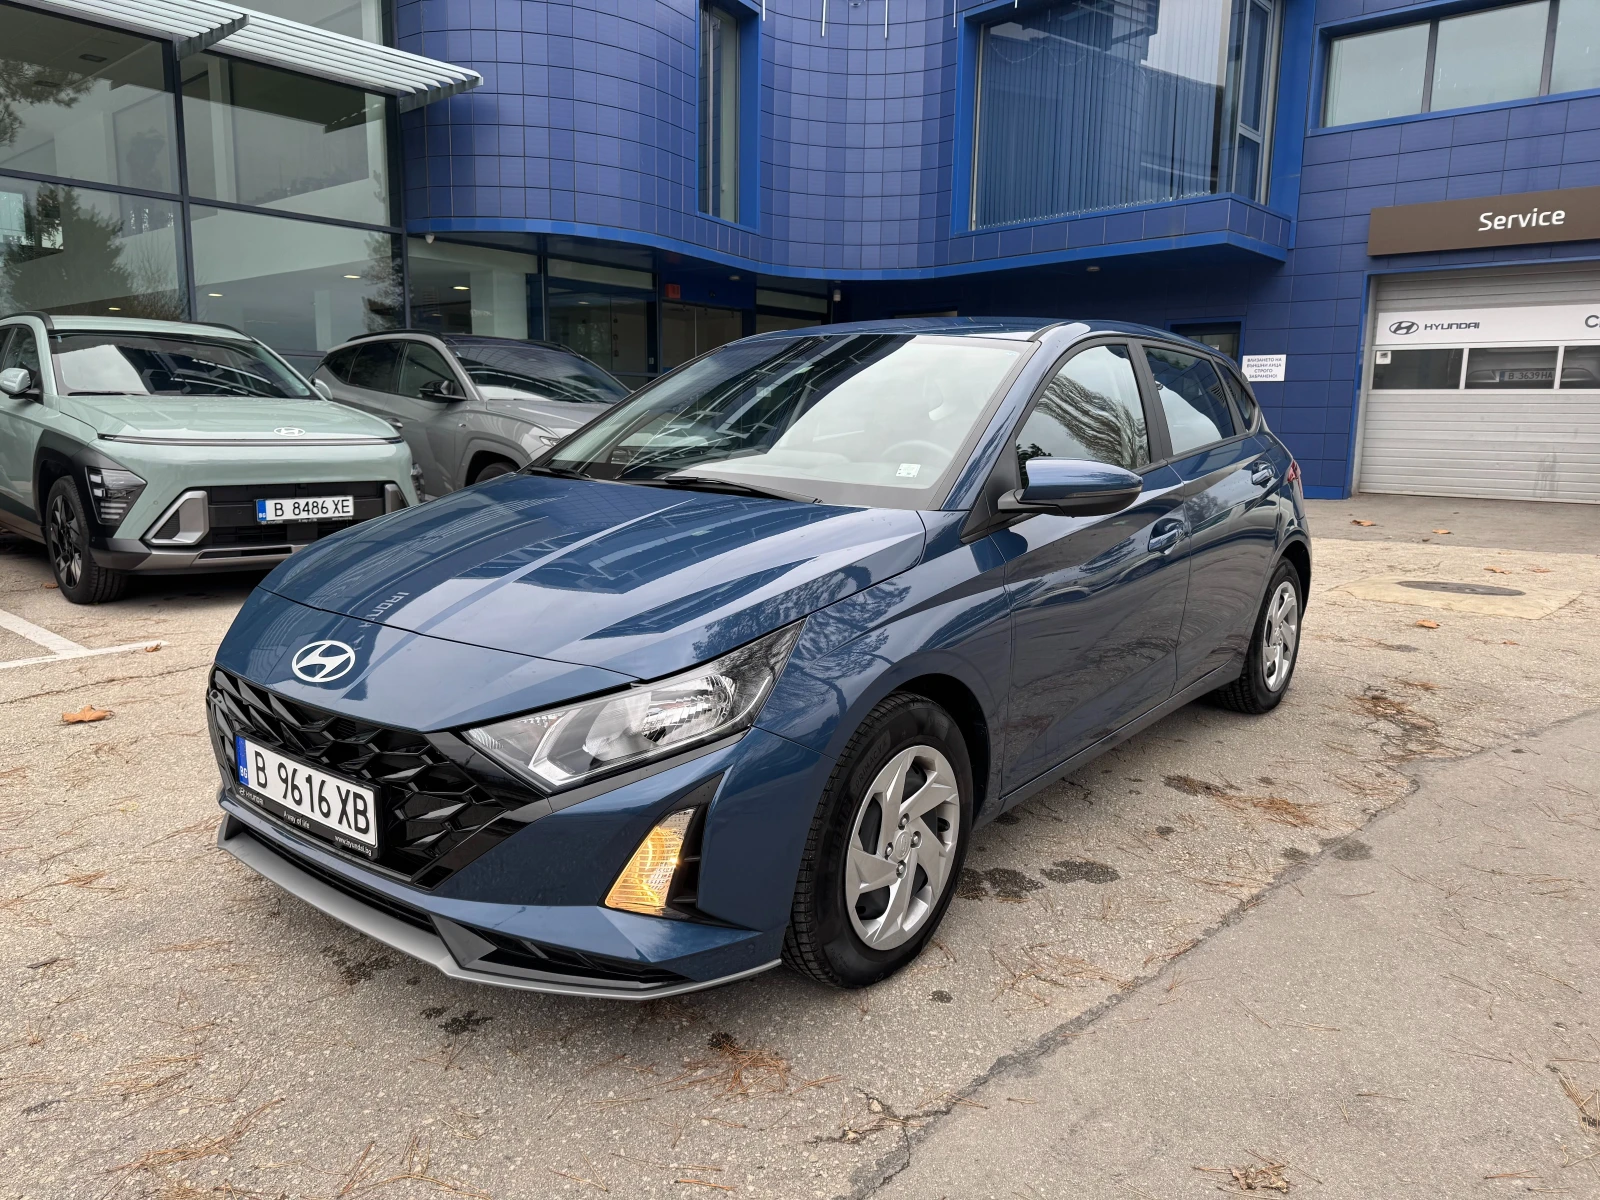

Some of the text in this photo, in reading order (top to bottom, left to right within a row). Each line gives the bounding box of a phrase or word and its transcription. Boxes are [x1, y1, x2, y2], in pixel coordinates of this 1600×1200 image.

[1478, 207, 1566, 231] Service
[1424, 321, 1480, 331] HYUNDAI
[1585, 314, 1600, 328] C
[1518, 371, 1541, 380] 3639
[292, 500, 329, 516] 8486
[332, 499, 351, 514] XE
[239, 765, 248, 779] BG
[254, 750, 370, 835] B 9616 XB
[302, 819, 310, 829] life
